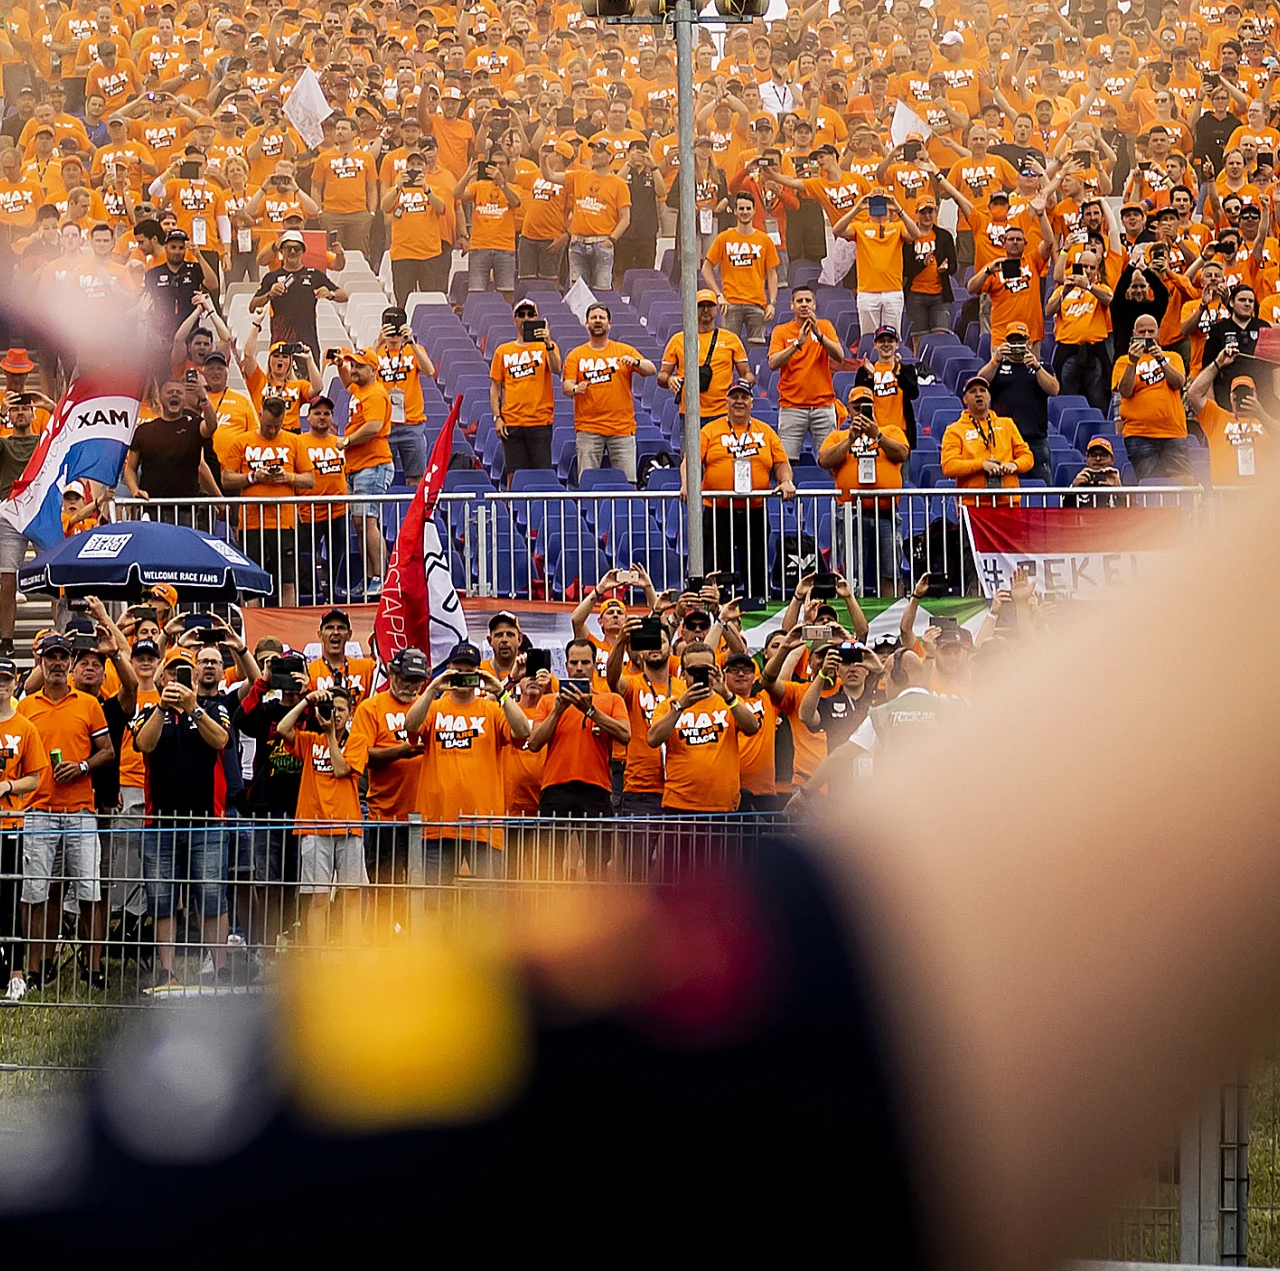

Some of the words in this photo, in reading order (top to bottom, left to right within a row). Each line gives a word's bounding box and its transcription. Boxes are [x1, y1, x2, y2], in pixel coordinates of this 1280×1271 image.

[98, 71, 128, 86] MAX
[944, 69, 974, 80] MAX
[145, 127, 176, 139] MAX
[331, 158, 364, 170] MAX
[897, 170, 929, 181] MAX
[962, 166, 996, 178] MAX
[534, 178, 563, 195] MAX
[825, 183, 859, 200] MAX
[0, 191, 32, 204] MAX
[180, 189, 213, 201] MAX
[726, 242, 762, 257] MAX
[504, 351, 543, 365] MAX
[579, 357, 619, 372] MAX
[721, 432, 765, 448] MAX
[245, 446, 289, 463] MAX
[308, 448, 345, 462] MAX
[317, 462, 328, 470] WE
[322, 465, 340, 473] BACK
[144, 571, 179, 580] WELCOME
[180, 573, 198, 581] RACE
[199, 574, 218, 583] FANS
[435, 712, 485, 734] MAX
[675, 710, 728, 731] MAX
[682, 728, 699, 736] WE
[689, 732, 715, 744] BACK
[445, 738, 469, 748] BACK
